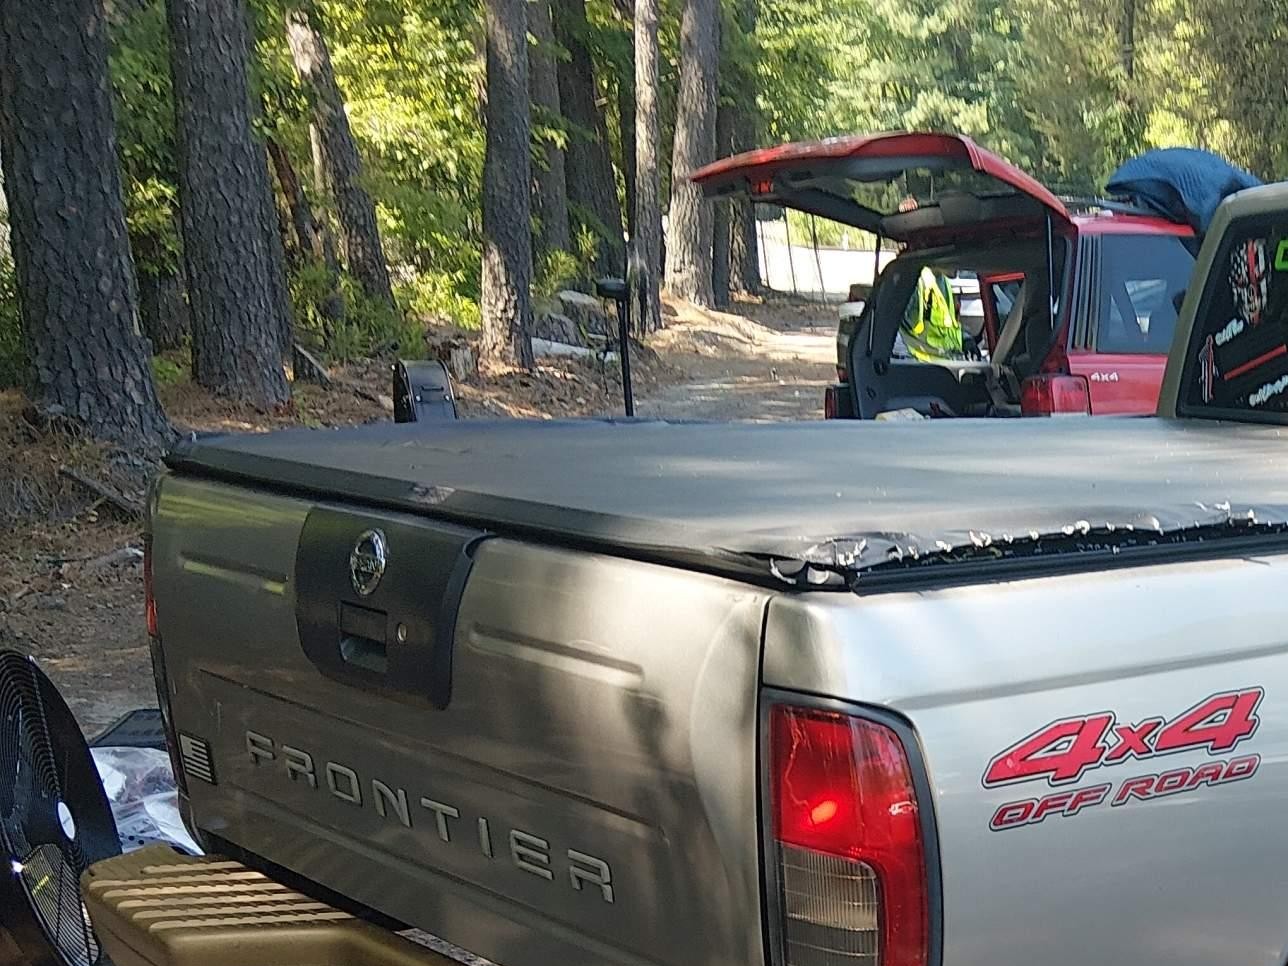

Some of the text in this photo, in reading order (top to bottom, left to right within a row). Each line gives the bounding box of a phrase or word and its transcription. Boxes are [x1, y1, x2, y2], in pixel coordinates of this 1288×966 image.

[1090, 371, 1119, 382] 4x4
[982, 686, 1264, 789] 4x4
[246, 730, 614, 903] FRONTIER
[989, 753, 1261, 831] OFF ROAD
